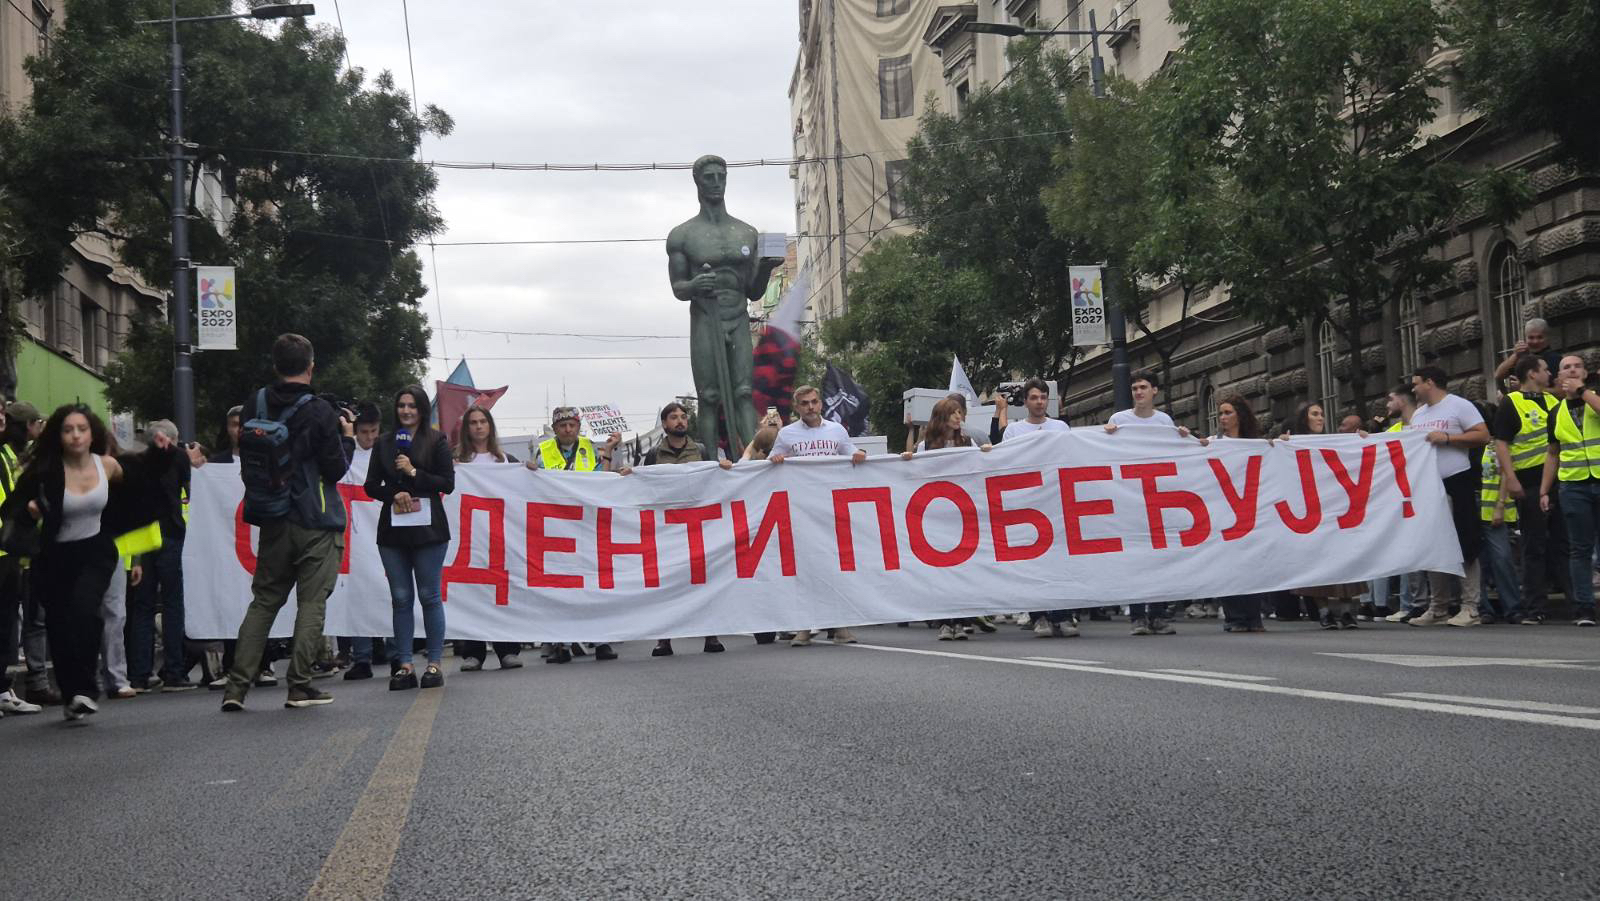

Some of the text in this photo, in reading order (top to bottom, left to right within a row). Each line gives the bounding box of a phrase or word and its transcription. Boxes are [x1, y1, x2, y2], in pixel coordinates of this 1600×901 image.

[1074, 307, 1102, 315] EXPO
[201, 318, 233, 326] 2027
[1074, 316, 1103, 324] 2027
[791, 439, 840, 453] СТУДЕНТИ
[234, 441, 1416, 606] ТДЕНТИ ПОБЕЂУЈУ!
